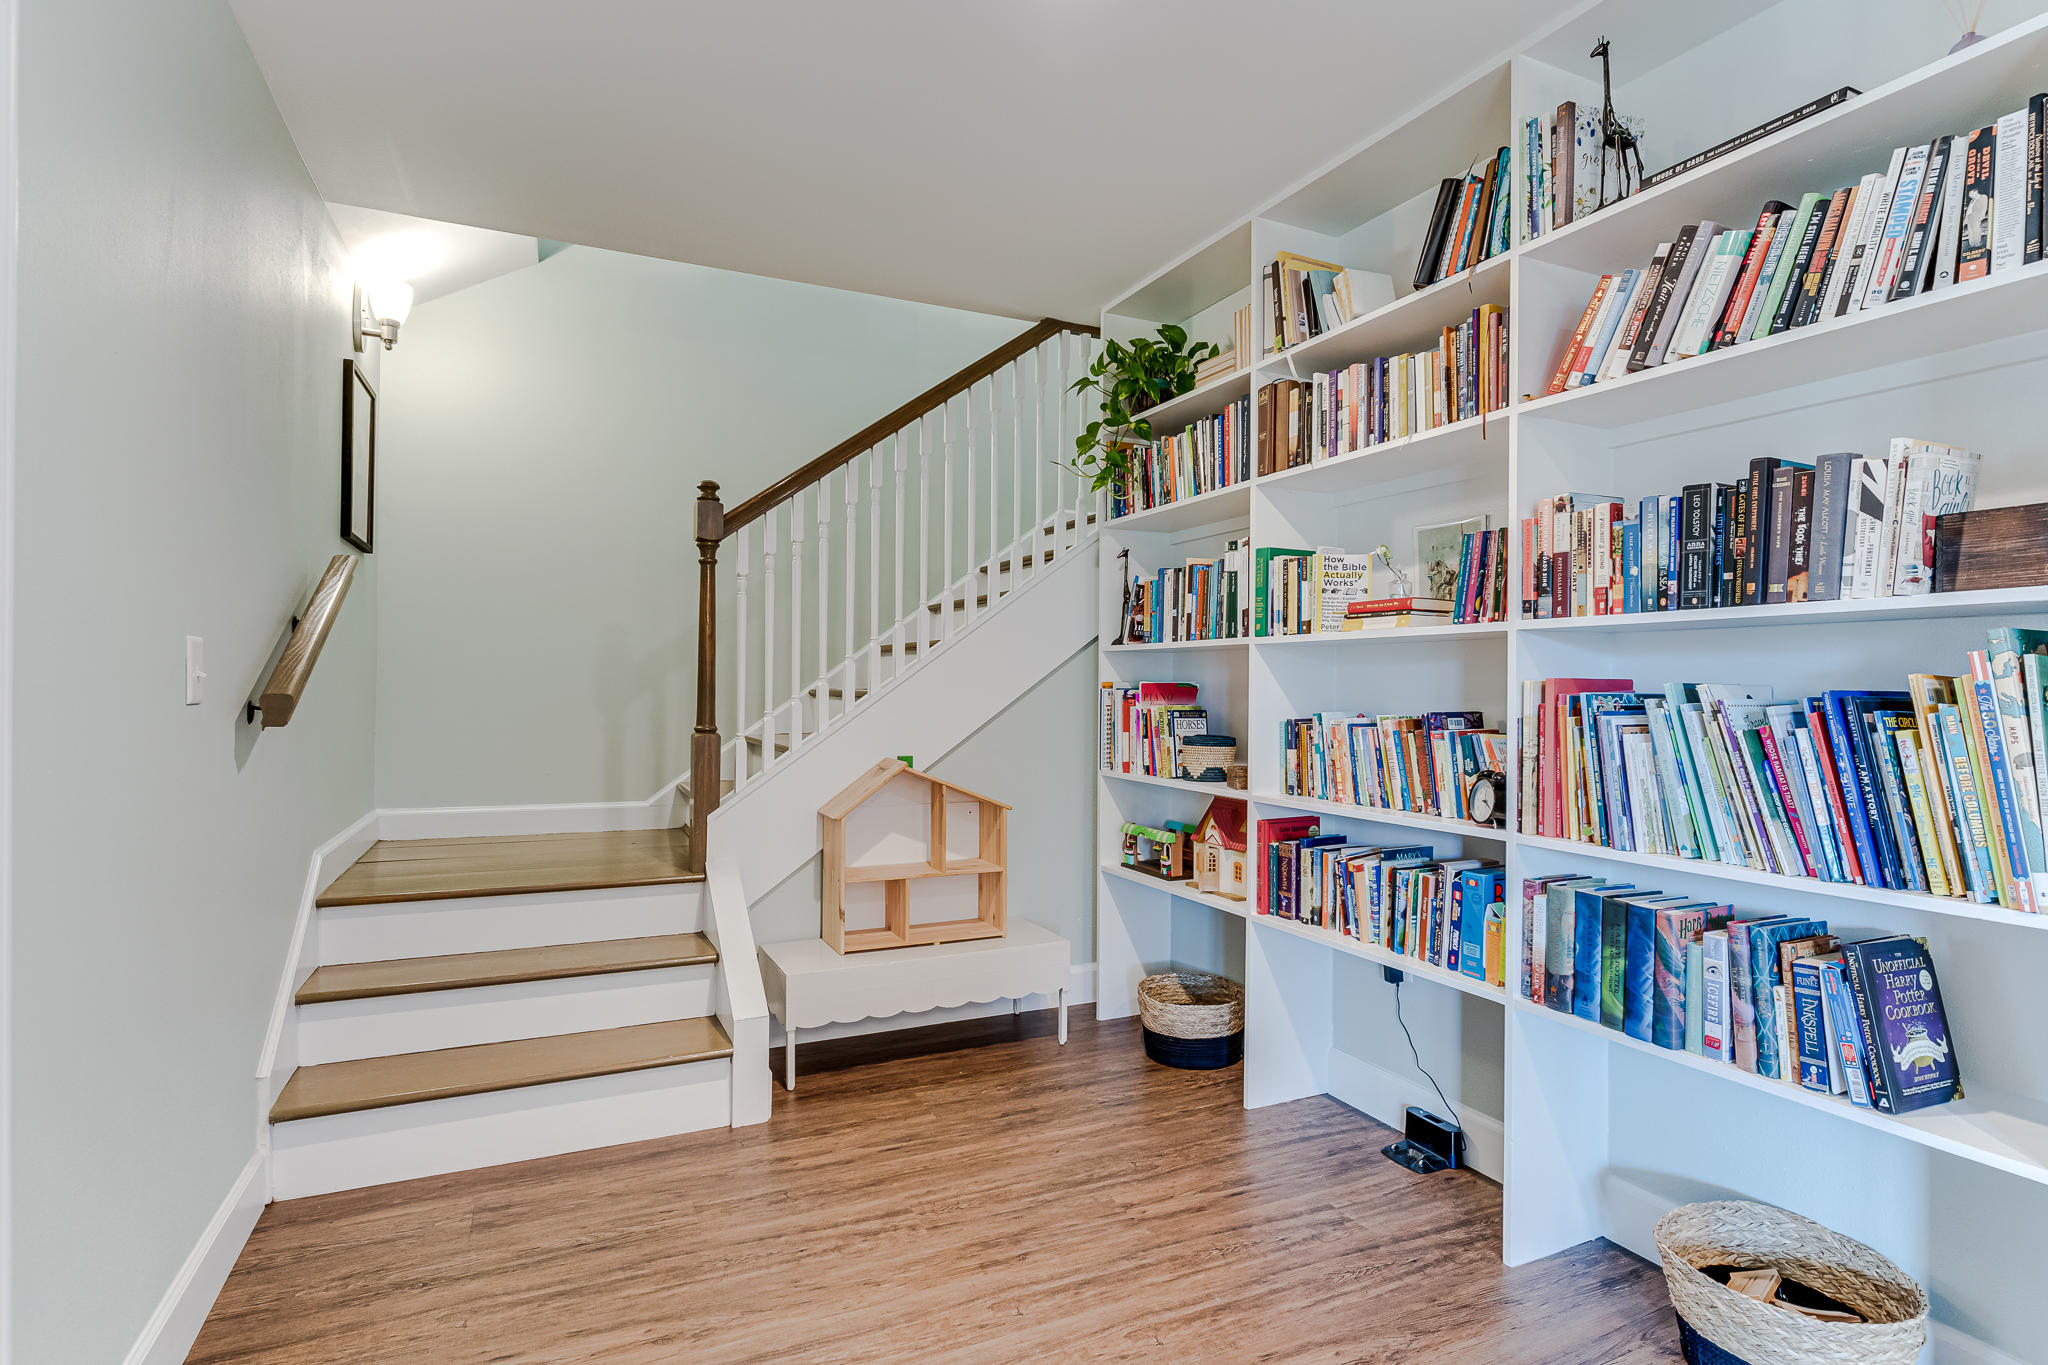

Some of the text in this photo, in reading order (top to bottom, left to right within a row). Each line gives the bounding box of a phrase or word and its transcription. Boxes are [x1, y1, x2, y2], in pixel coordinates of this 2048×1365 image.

[1800, 103, 1817, 115] CASH
[1650, 153, 1706, 184] HOUSE OF CASH
[1964, 147, 1978, 185] GROVE
[1978, 144, 1992, 181] DEVIL
[1948, 173, 1962, 198] Mercy
[1828, 189, 1846, 218] JAMES
[1884, 175, 1917, 241] STAMPED
[1866, 189, 1891, 251] WHITE FRAGILITY
[1670, 234, 1687, 267] FARMER
[1678, 240, 1690, 262] PAUL
[1795, 209, 1822, 266] I'M STILL HERE
[1962, 247, 1986, 257] GILBERT
[1638, 263, 1662, 310] PATHOLOGIES
[1654, 274, 1677, 305] Haiti
[1690, 257, 1727, 332] NIETZSCHE
[1634, 309, 1643, 319] OF
[1623, 319, 1639, 346] POWER
[1799, 475, 1808, 497] ZUSAK
[1820, 460, 1831, 533] LOUISA MAY ALCOTT
[1932, 468, 1964, 510] Book
[1749, 470, 1760, 531] LITTLE FIRES EVERYWHERE
[1795, 505, 1808, 522] THE
[1691, 494, 1701, 537] LEO TOLSTOY
[1737, 493, 1746, 537] GATES OF FIRE
[1323, 555, 1345, 563] How
[1714, 534, 1722, 566] BRITCHES
[1793, 545, 1805, 566] THIEF
[1864, 517, 1876, 577] CRIME PUNISHMENT
[1323, 563, 1367, 571] the Bible
[1323, 571, 1364, 580] Actually
[1658, 576, 1667, 591] SEA
[1734, 577, 1742, 603] PRESSFIELD
[1176, 719, 1206, 730] HORSES
[1883, 716, 1919, 728] THE CIRCL
[1944, 713, 1958, 736] MANN
[1976, 693, 2004, 756] The 50 States
[2007, 725, 2019, 745] MAPS
[1764, 737, 1796, 810] WHOSE HABITAT IS THAT?
[1858, 767, 1870, 785] AM
[1838, 771, 1857, 810] SULWE
[1863, 785, 1871, 793] A
[1909, 782, 1923, 799] BIG
[1952, 754, 1987, 849] BEFORE COLUMBUS
[1864, 792, 1879, 822] STORY
[1396, 851, 1423, 861] MARY'S
[1925, 855, 1938, 869] ME
[1679, 916, 1705, 939] Harry
[1613, 960, 1621, 995] POTTER
[1872, 956, 1927, 974] UNOFFICIAL
[1796, 975, 1819, 987] FUNKE
[1706, 981, 1719, 1023] ICEFIRE
[1885, 1002, 1937, 1021] COOKBOOK
[1798, 995, 1823, 1055] INKSPELL
[1866, 1044, 1883, 1087] COOKBOOK
